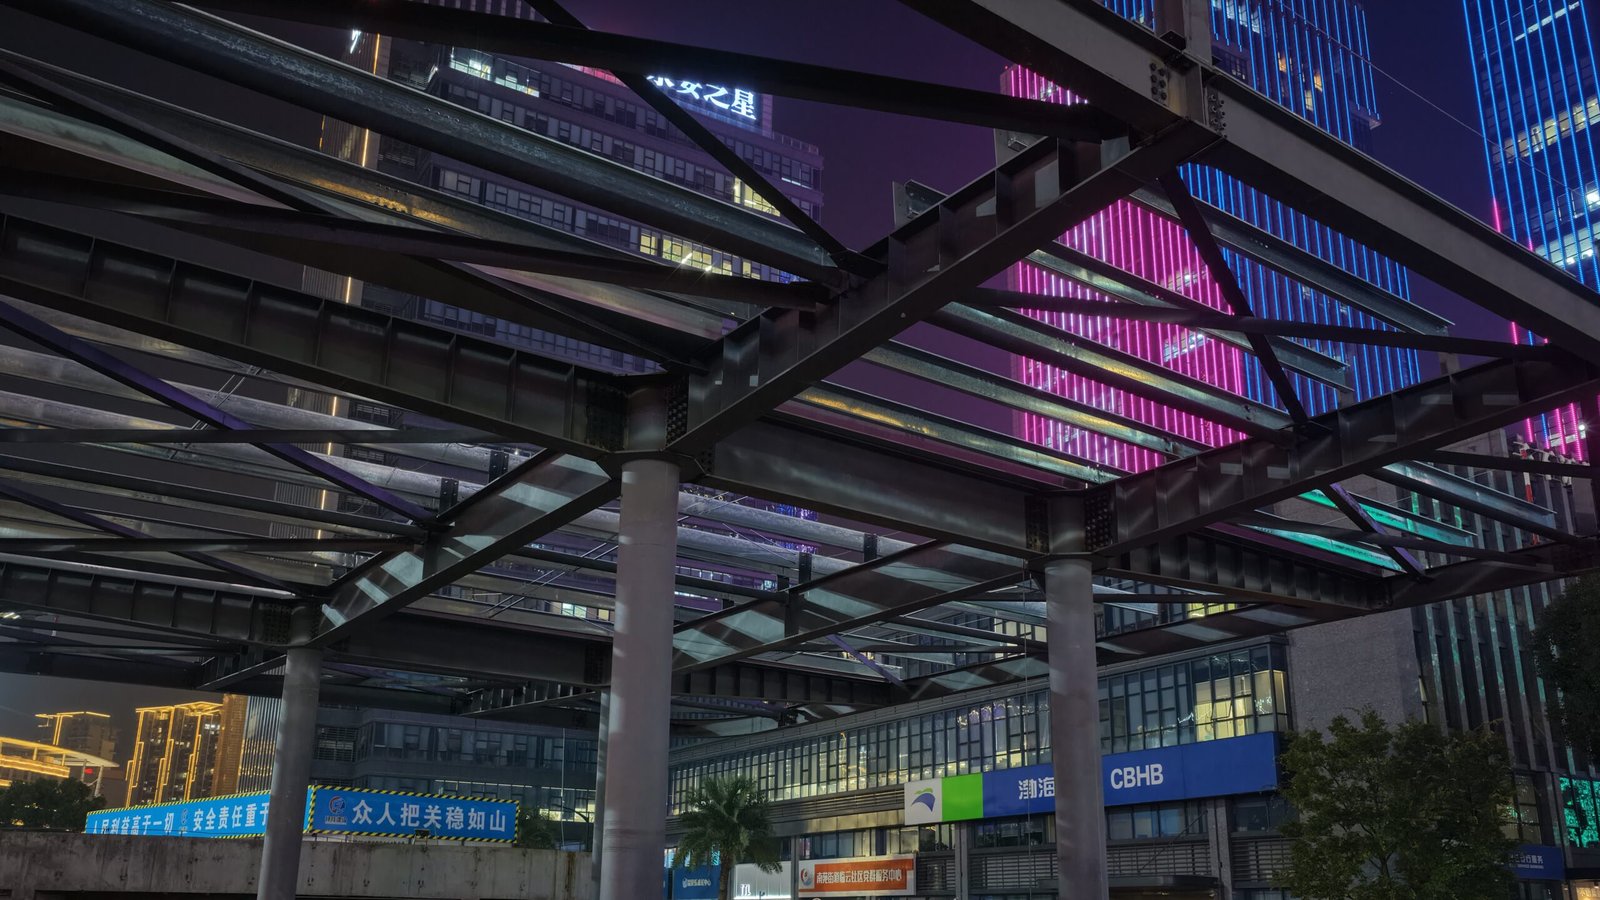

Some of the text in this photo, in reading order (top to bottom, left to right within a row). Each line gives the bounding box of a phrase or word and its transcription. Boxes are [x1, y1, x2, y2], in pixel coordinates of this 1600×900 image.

[1018, 763, 1164, 800] 渤海 CBHB
[351, 799, 506, 832] 众人把关稳如山
